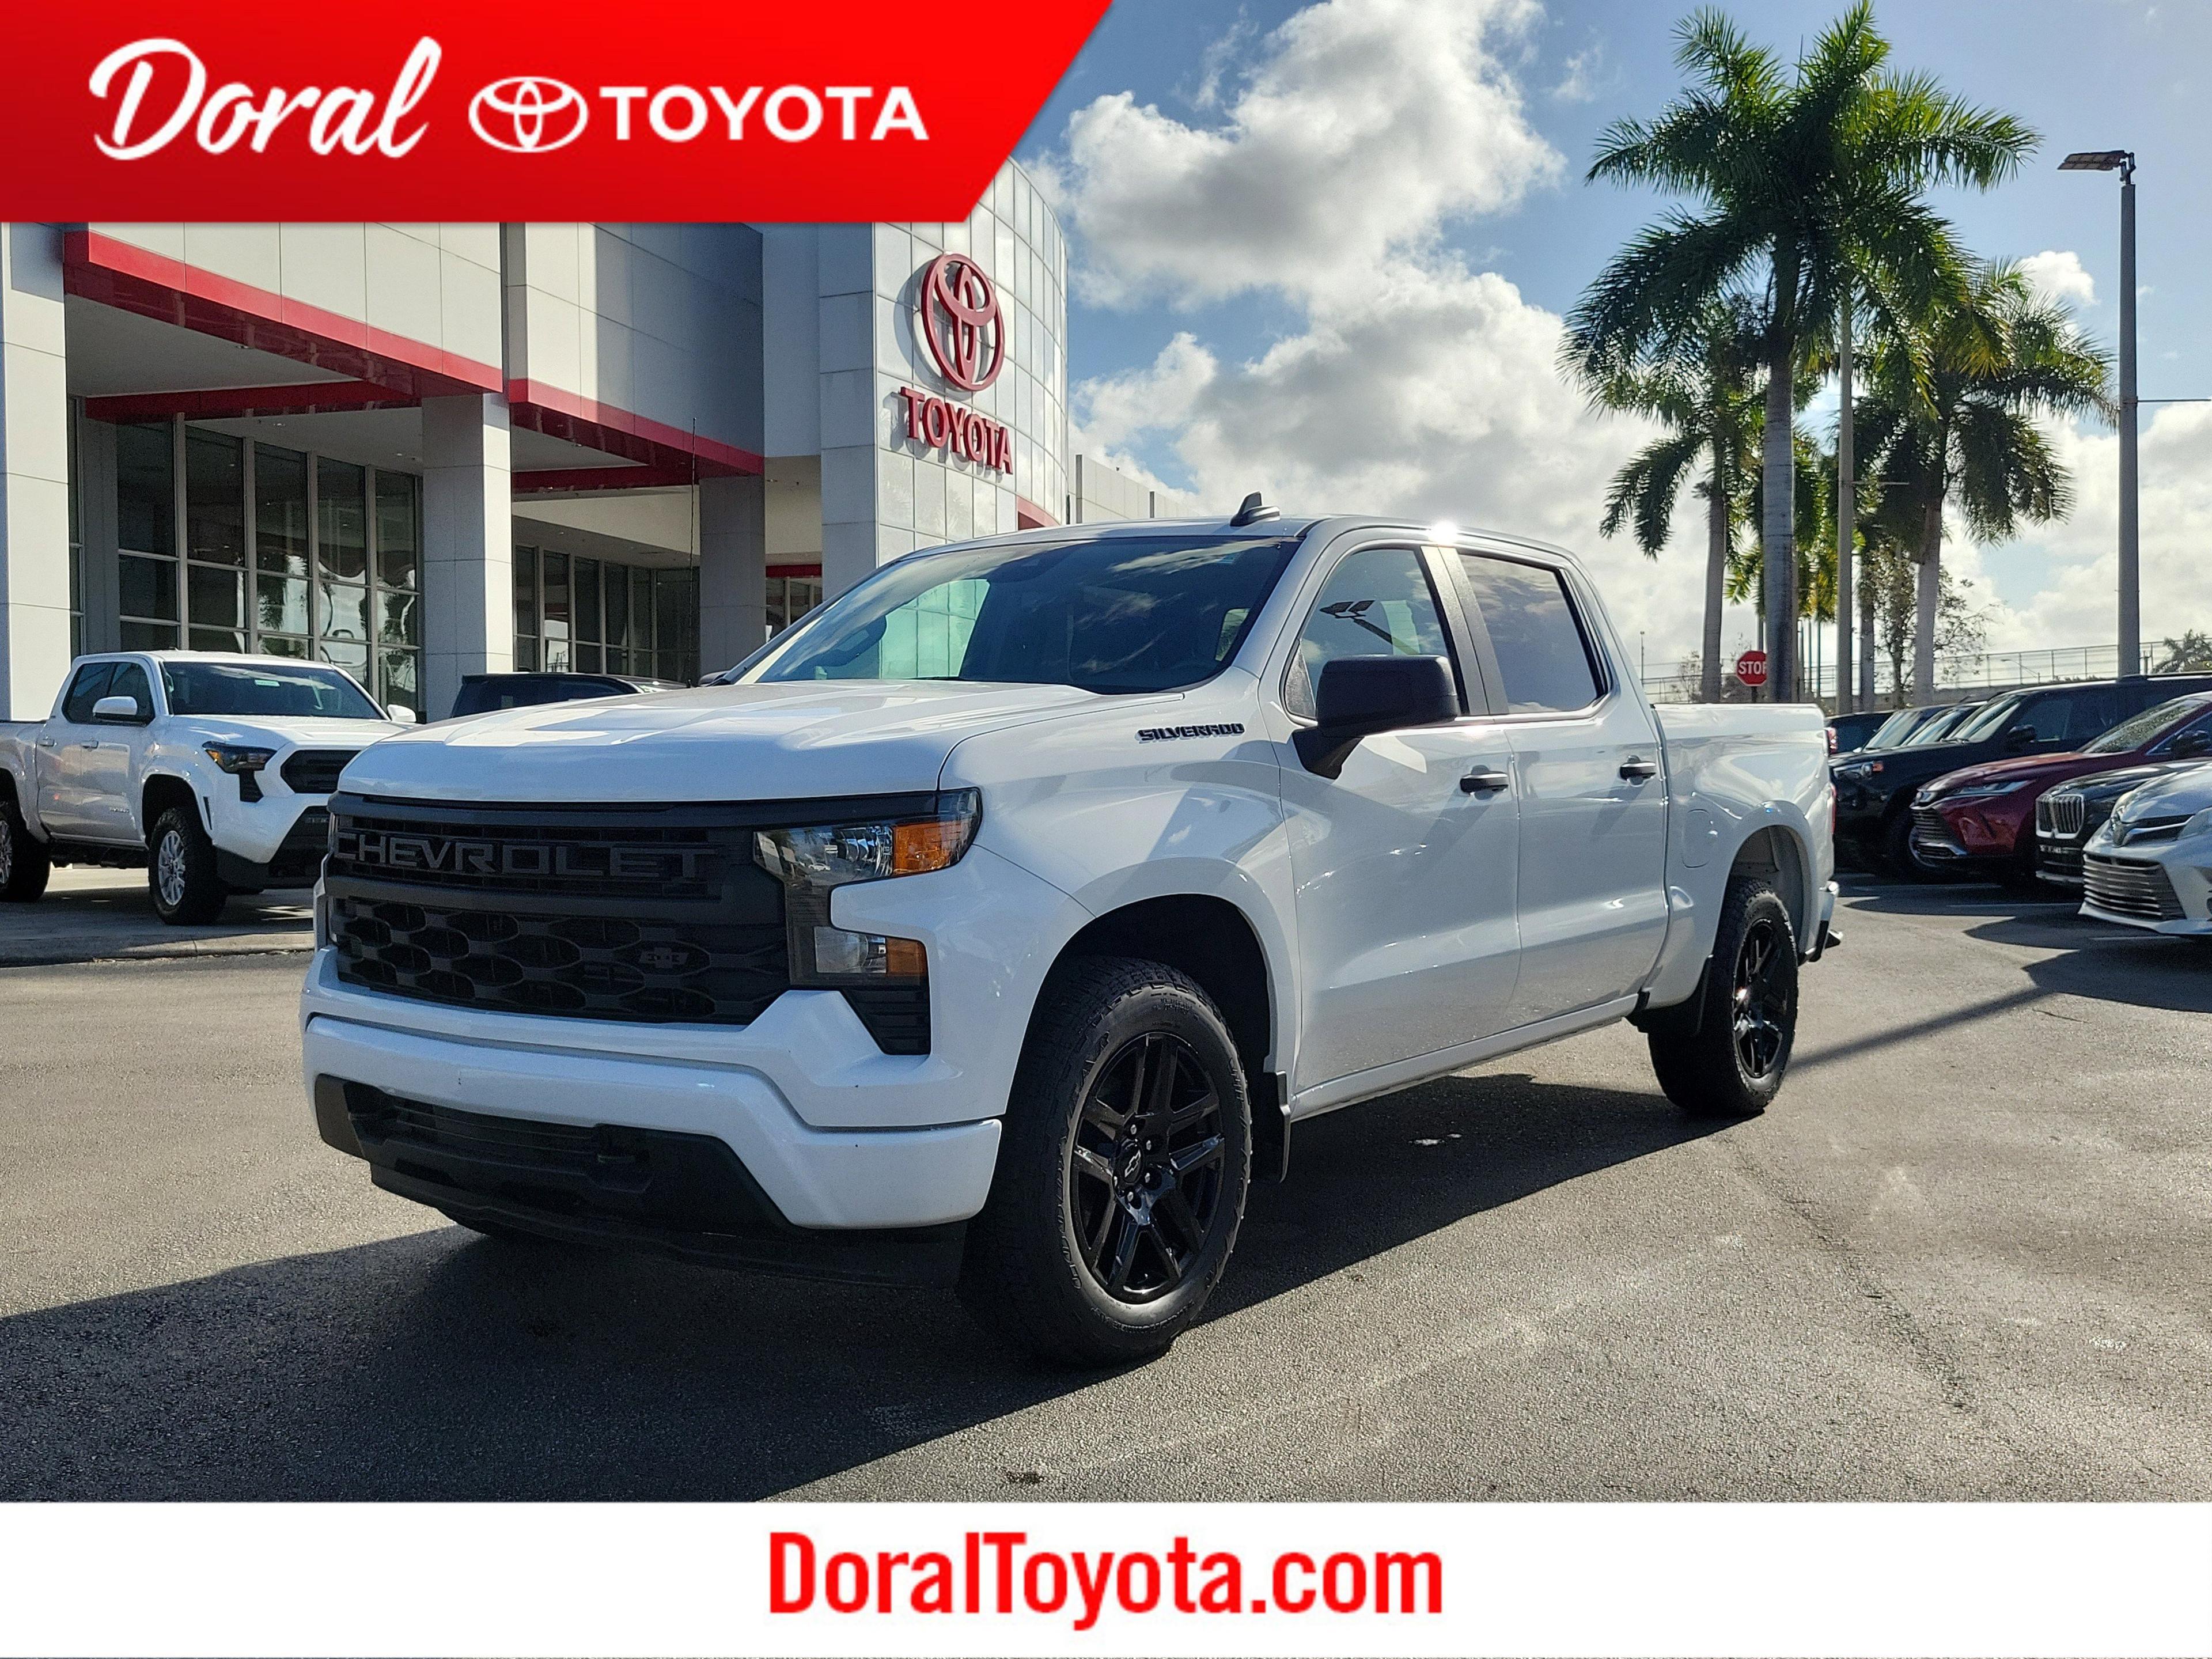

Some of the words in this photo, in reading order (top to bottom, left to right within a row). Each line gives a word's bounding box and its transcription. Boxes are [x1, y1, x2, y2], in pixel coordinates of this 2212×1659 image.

[899, 386, 1013, 475] TOYOTA
[1136, 723, 1245, 743] SILVERADO
[332, 832, 718, 878] CHEVROLET
